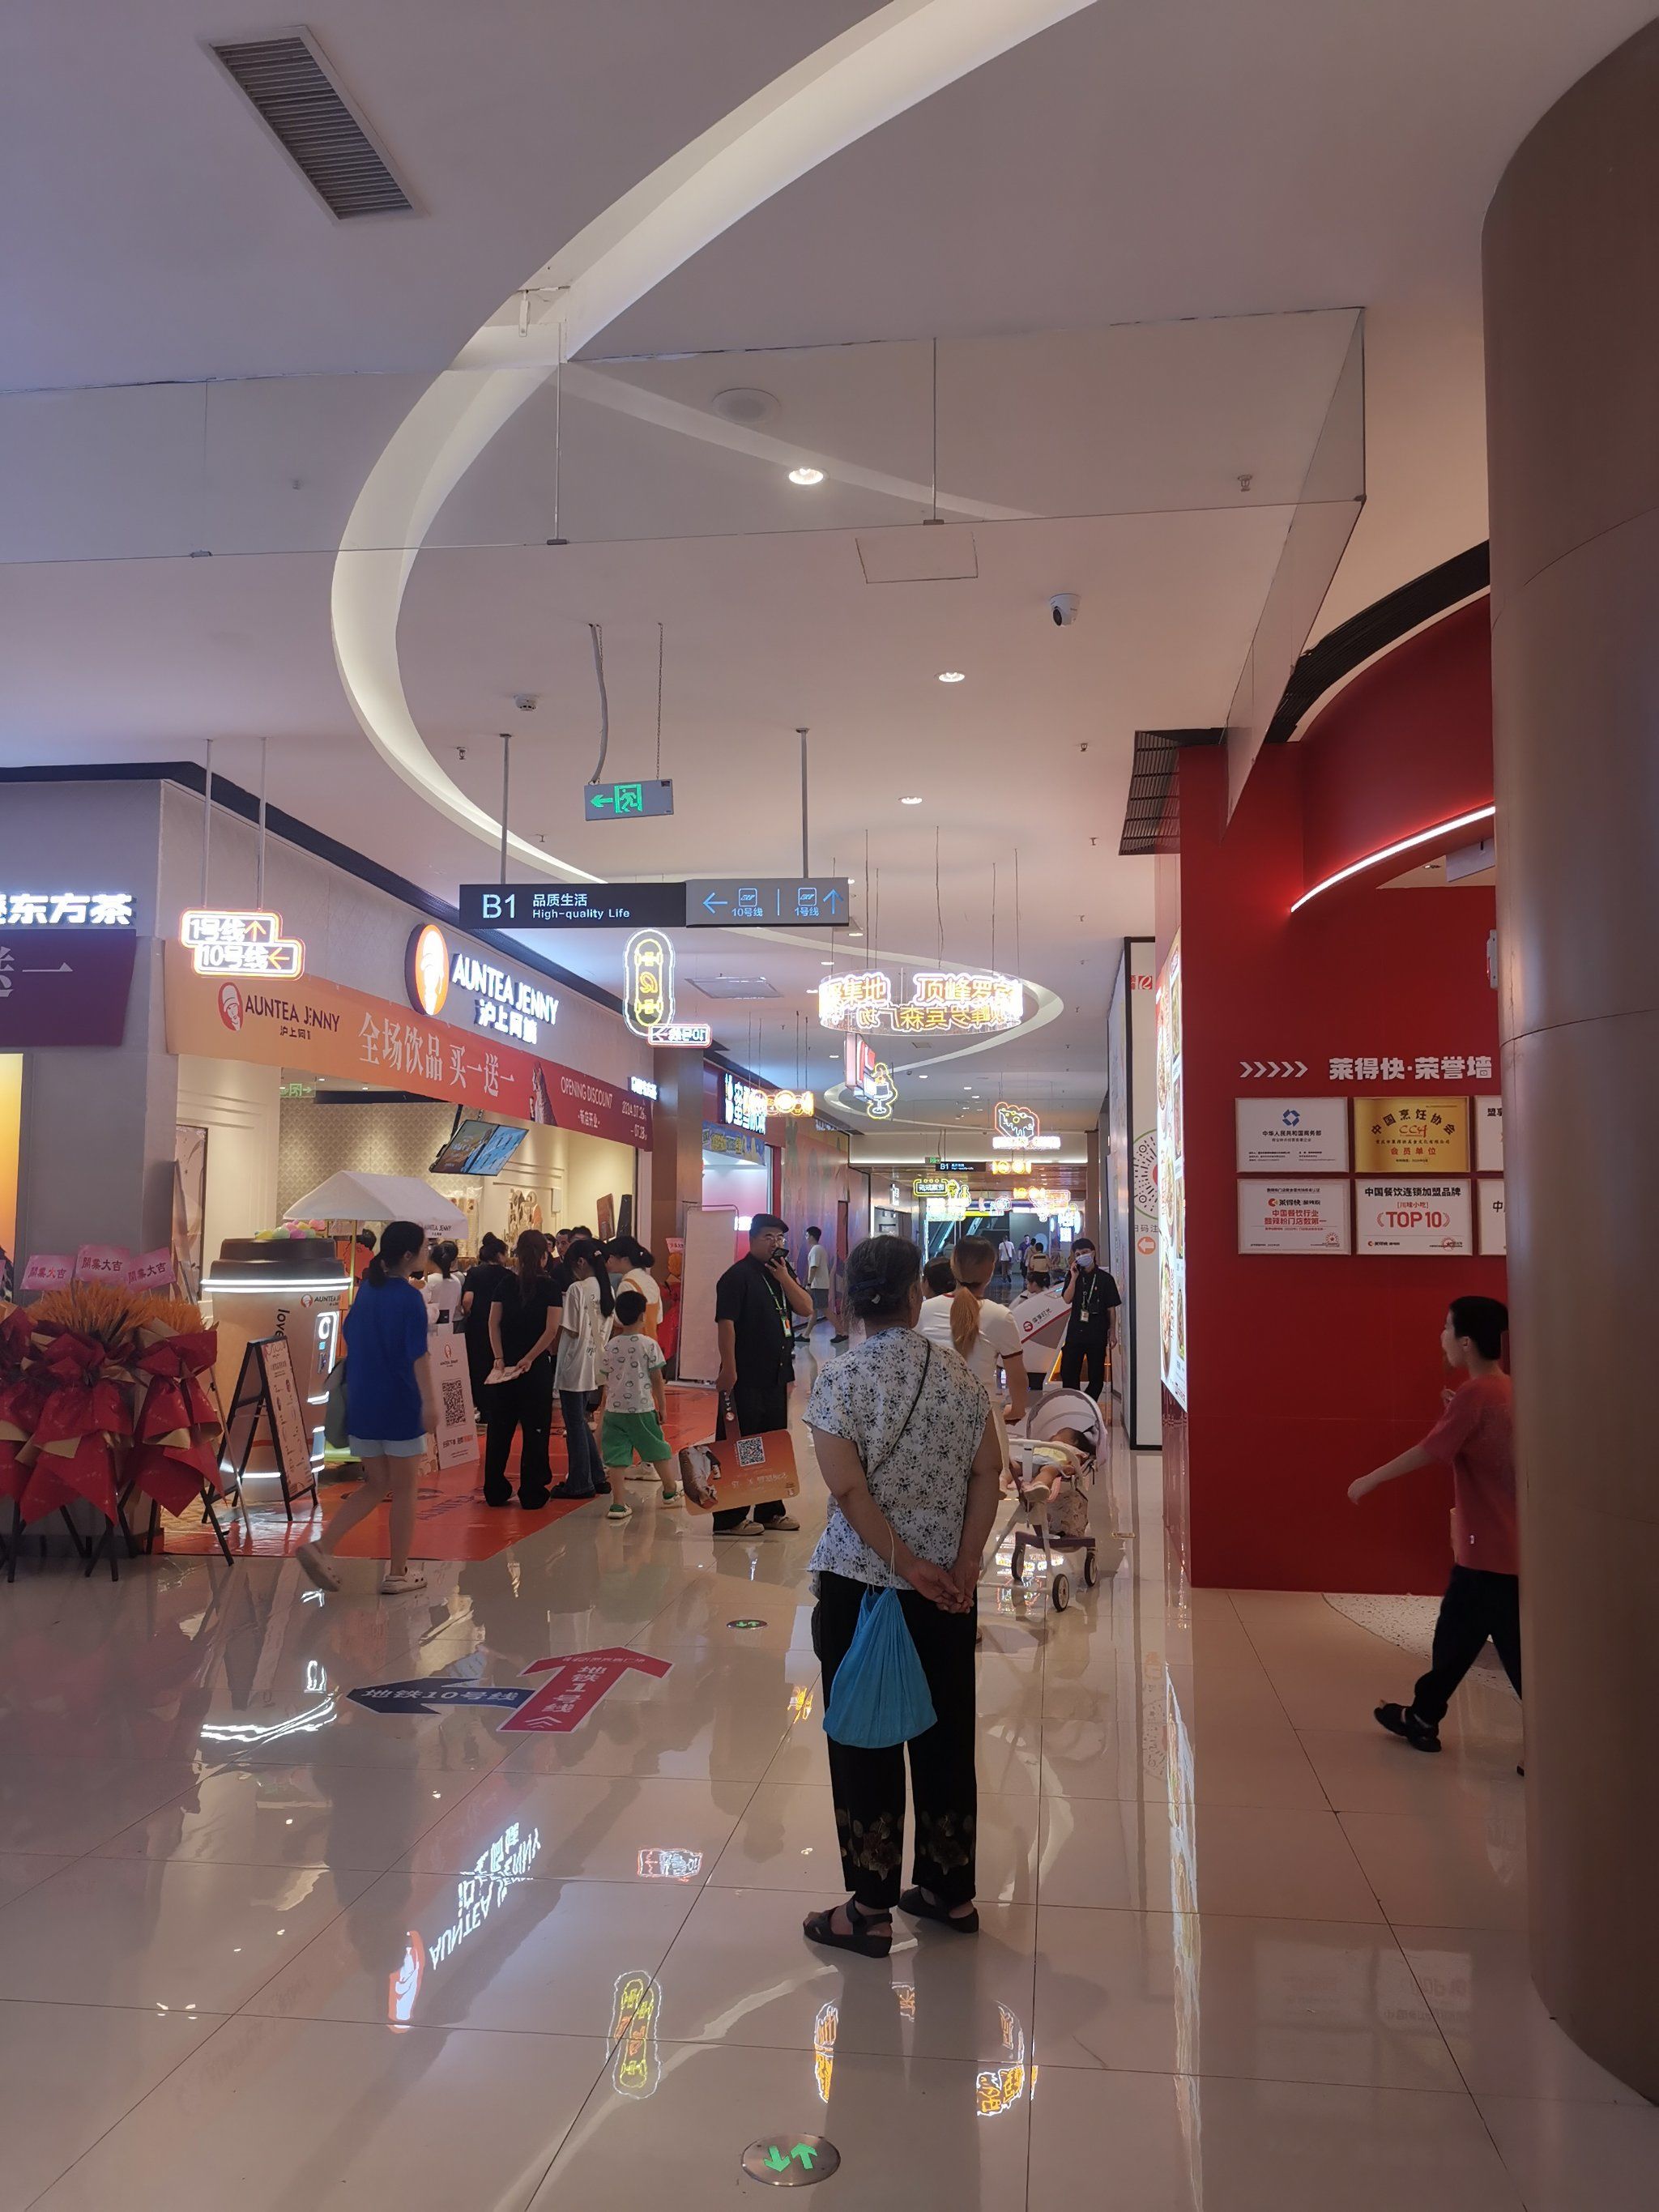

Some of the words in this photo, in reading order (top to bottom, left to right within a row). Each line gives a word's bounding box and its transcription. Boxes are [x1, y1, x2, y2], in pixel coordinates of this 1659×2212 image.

[0, 893, 132, 924] 东方茶
[482, 894, 516, 918] B1
[532, 893, 588, 907] 品质生活
[731, 906, 763, 918] 10号线
[794, 906, 820, 918] 1号线
[532, 909, 604, 920] High-quality
[608, 909, 630, 918] Life
[190, 918, 245, 942] 1号线
[203, 944, 269, 970] 10号线
[452, 953, 514, 1005] AUNTEA
[515, 982, 560, 1025] JENNY
[245, 995, 299, 1022] AUNTEA
[358, 1012, 443, 1081] 全场饮品
[450, 1044, 515, 1097] 买一送一
[1328, 1056, 1492, 1080] 莱得快·荣誉墙
[561, 1076, 587, 1101] OPENING
[587, 1088, 613, 1110] DISCOUNT
[1371, 1108, 1456, 1136] 中国烹饪协会
[1390, 1147, 1437, 1156] 会员单位
[1365, 1187, 1461, 1197] 中国餐饮连锁加盟品牌
[1272, 1209, 1319, 1217] 中国餐饮行业
[361, 1689, 520, 1702] 地铁10号线
[541, 1665, 608, 1713] 地铁1号线
